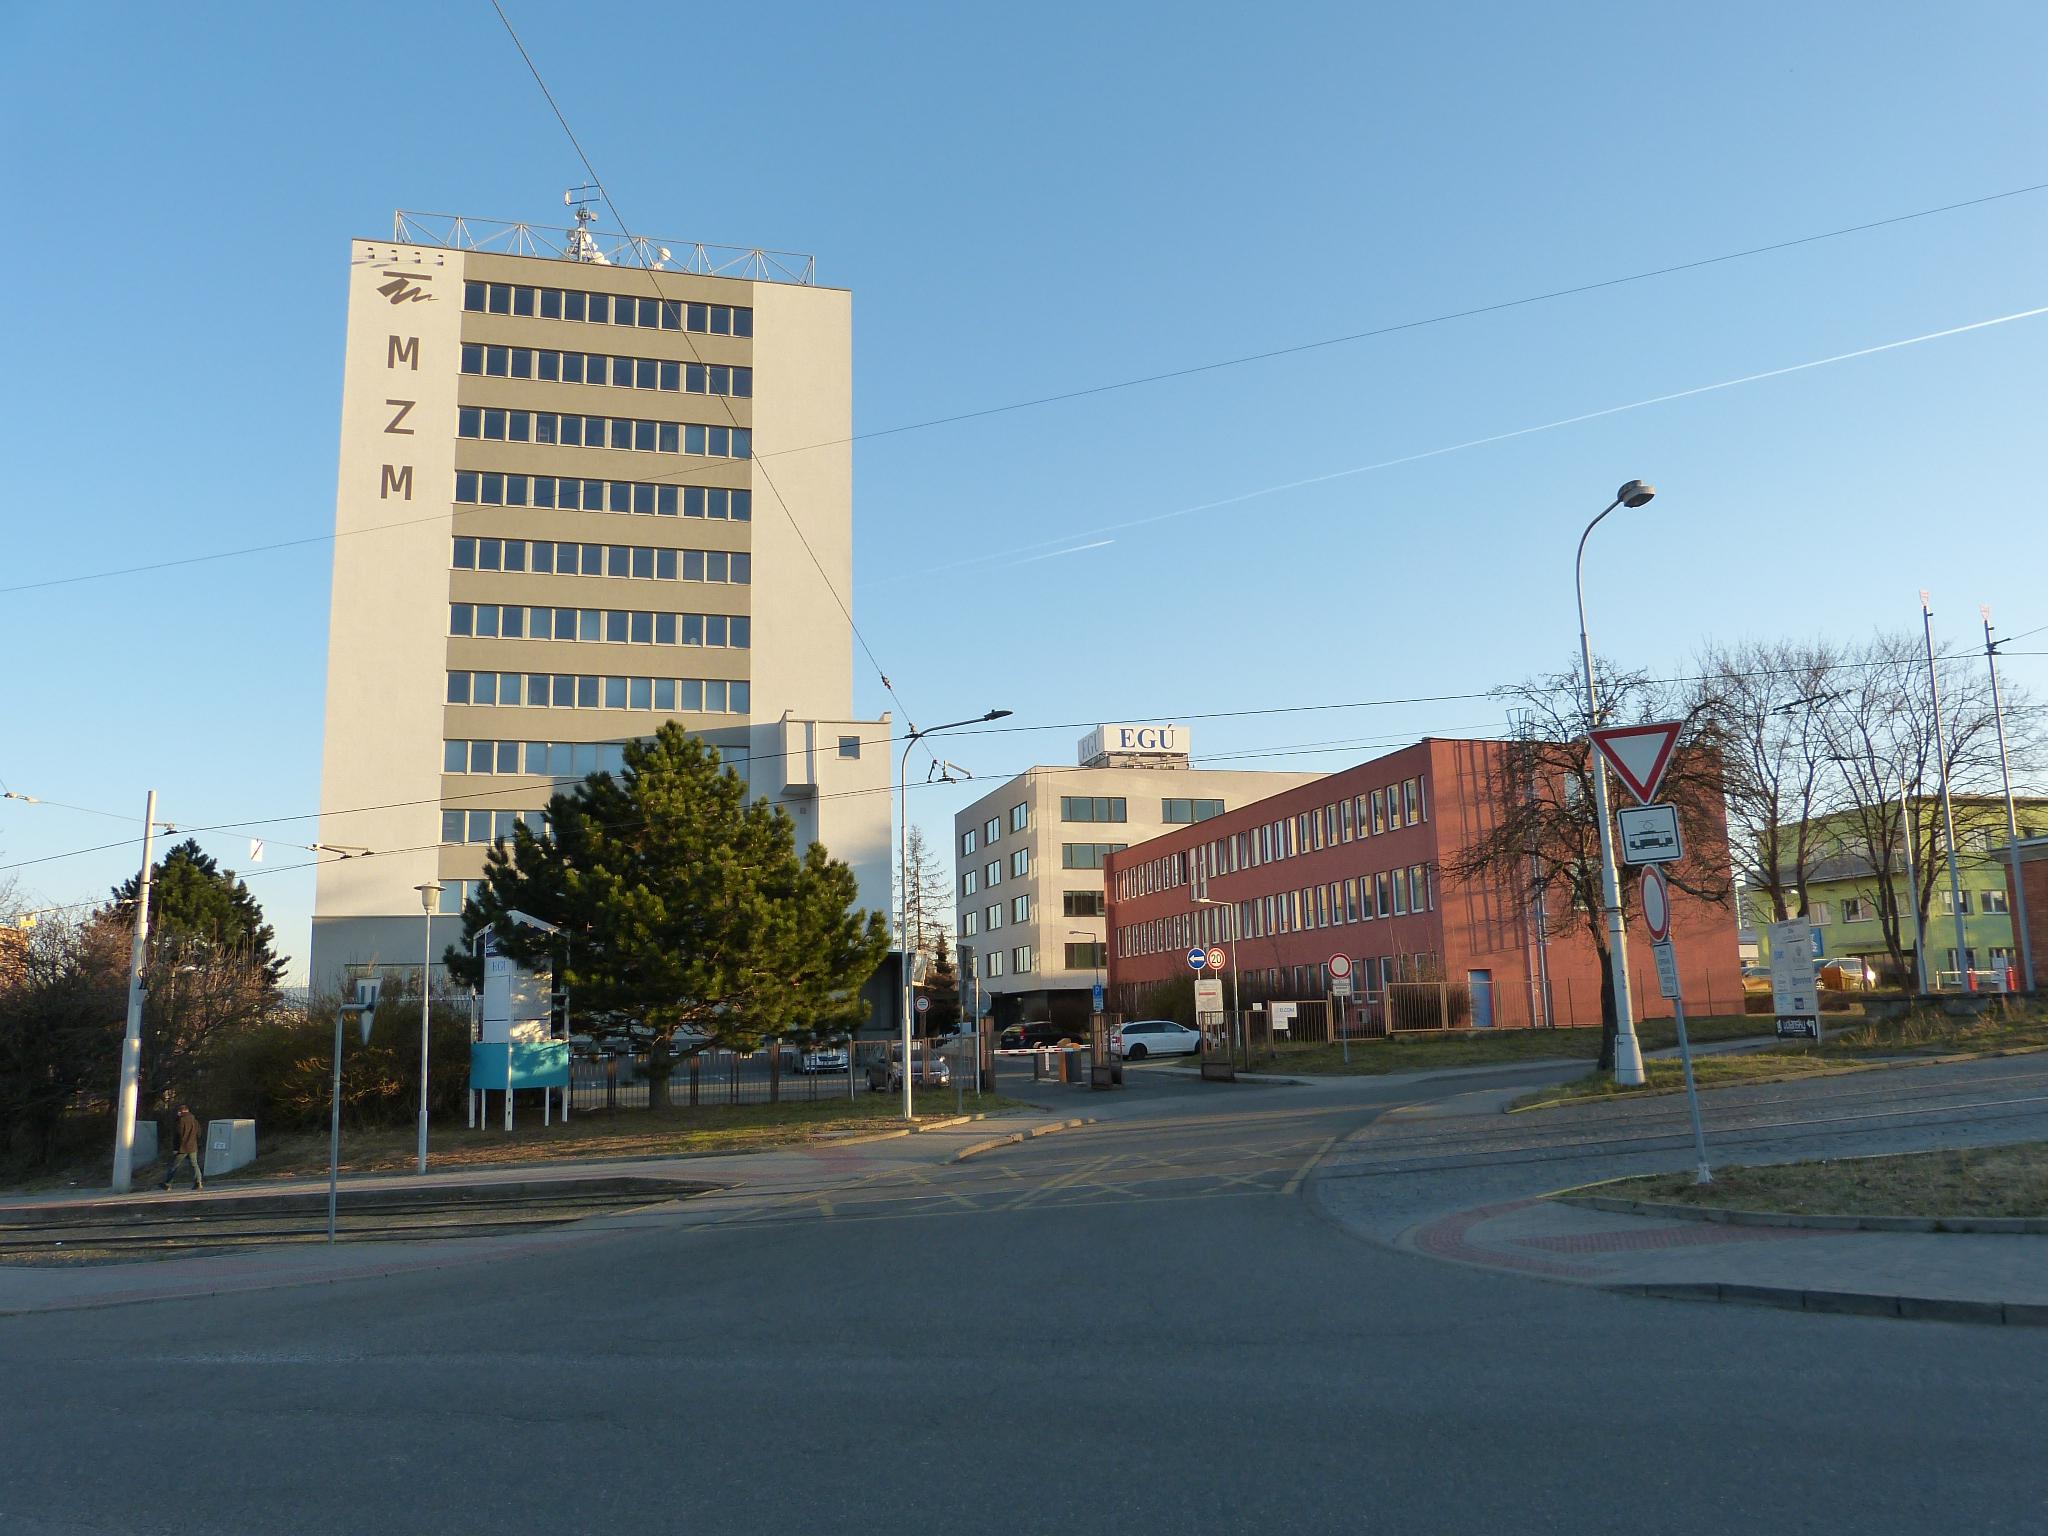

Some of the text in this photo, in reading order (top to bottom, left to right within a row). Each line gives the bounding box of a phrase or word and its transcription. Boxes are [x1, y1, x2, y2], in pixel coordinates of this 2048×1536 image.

[380, 335, 420, 501] MZM
[1119, 723, 1176, 750] EGÚ
[1211, 953, 1222, 964] 20
